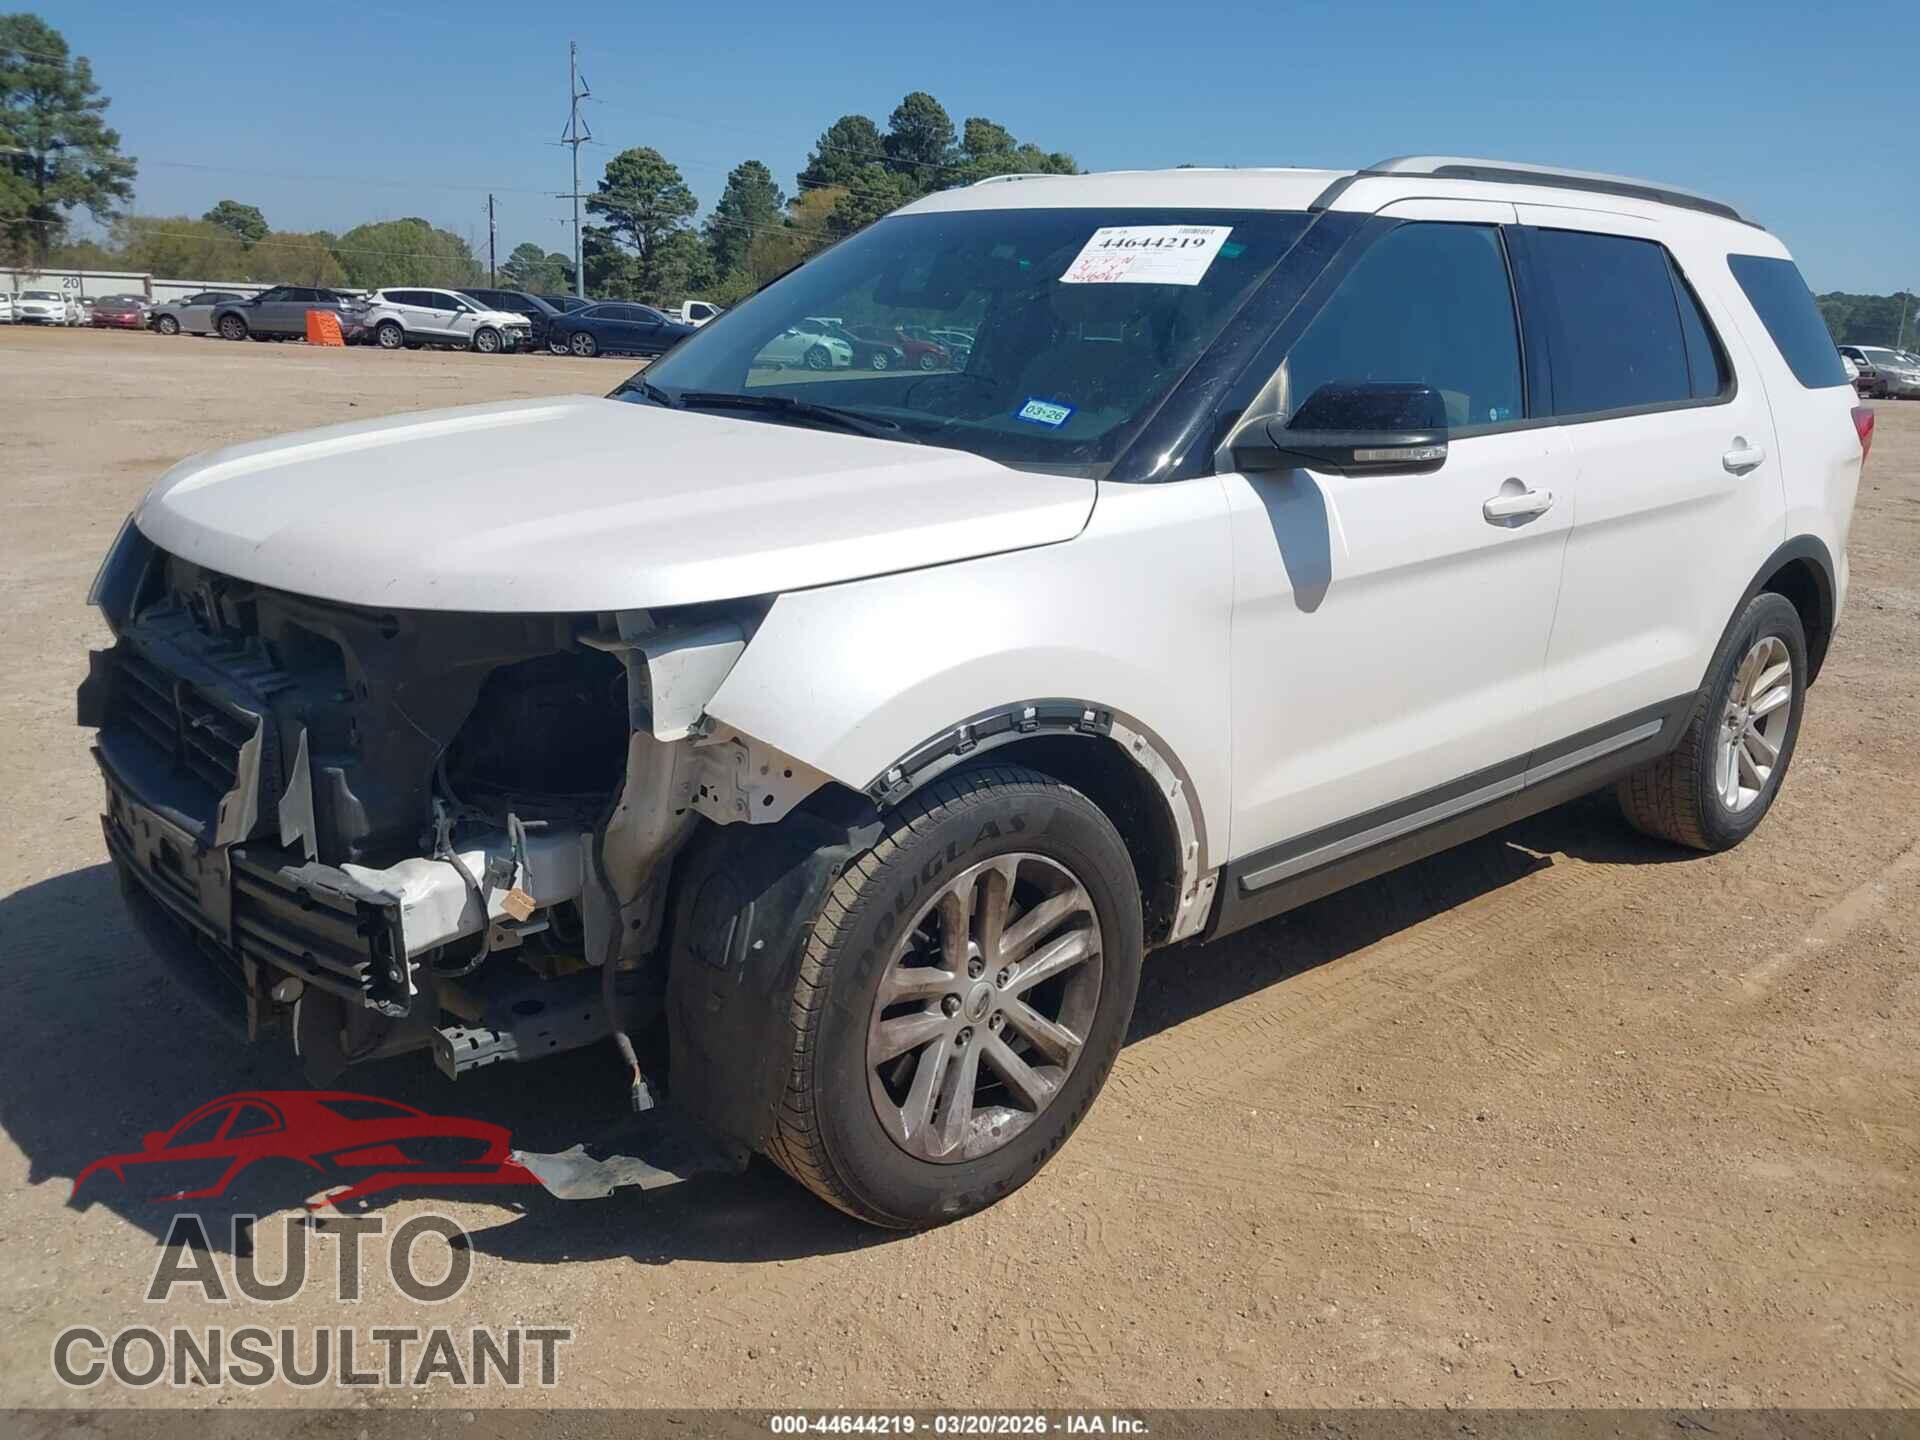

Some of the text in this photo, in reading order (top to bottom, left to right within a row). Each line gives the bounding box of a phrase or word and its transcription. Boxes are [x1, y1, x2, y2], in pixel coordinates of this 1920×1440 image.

[1098, 236, 1207, 249] 44644219
[63, 277, 79, 289] 20
[851, 809, 1032, 982] DOUGLAS
